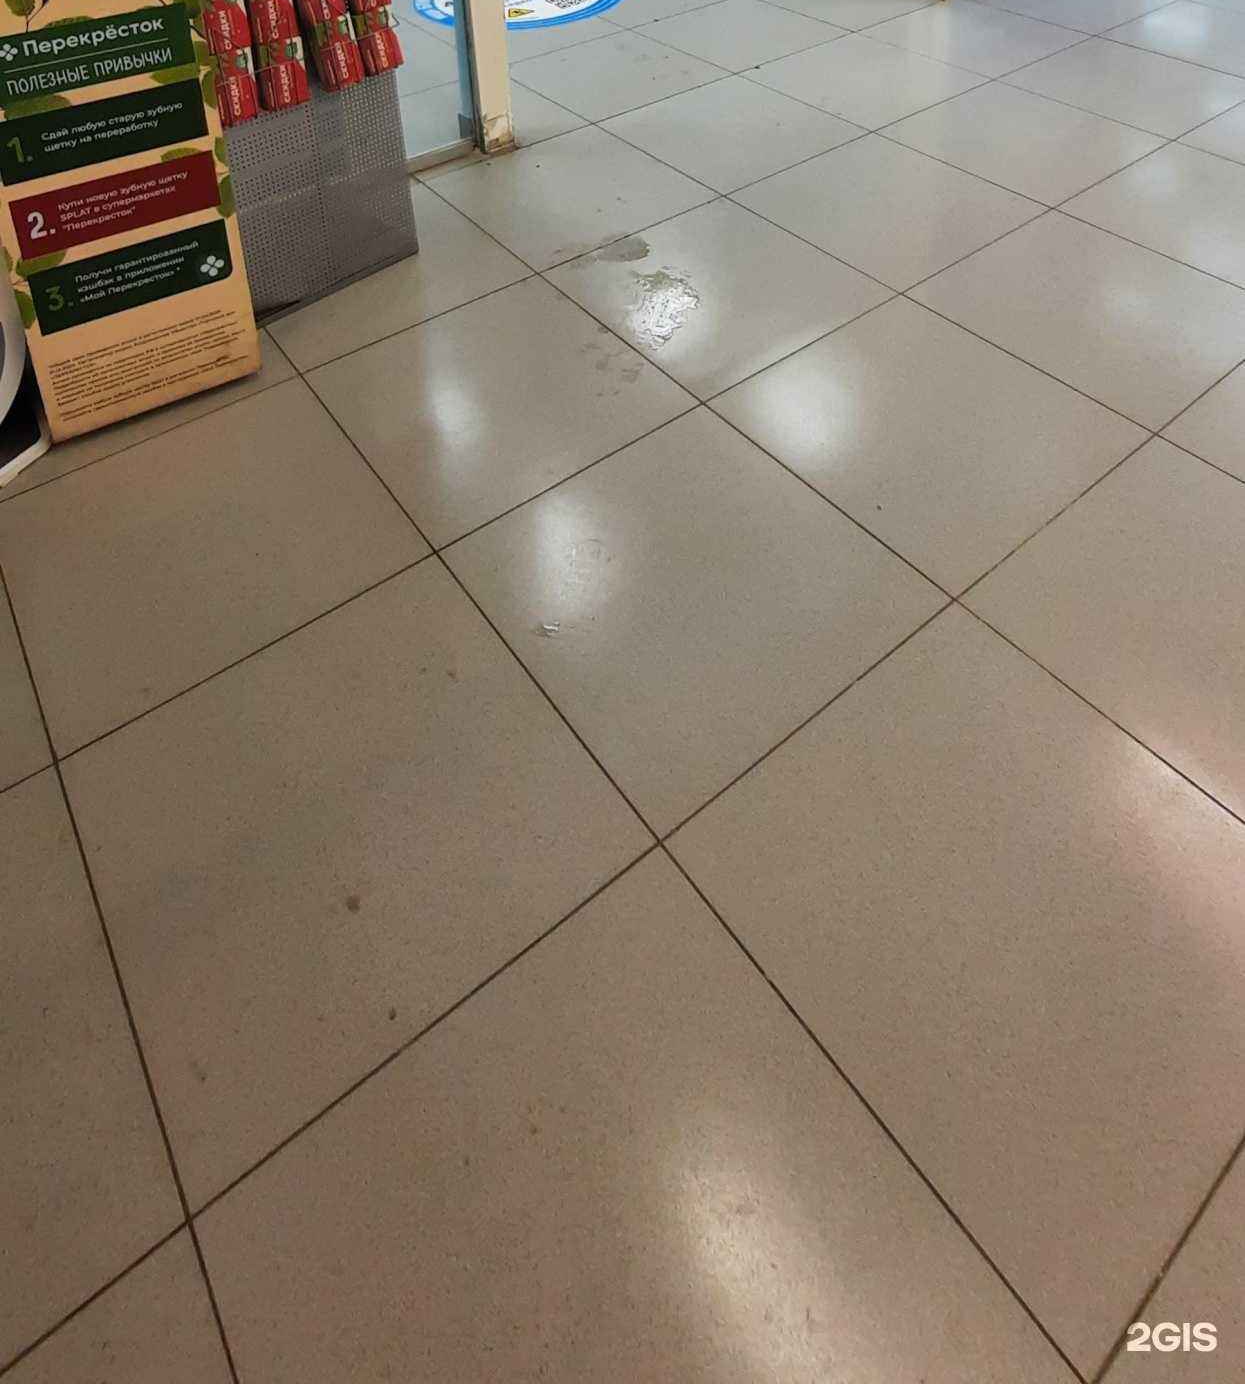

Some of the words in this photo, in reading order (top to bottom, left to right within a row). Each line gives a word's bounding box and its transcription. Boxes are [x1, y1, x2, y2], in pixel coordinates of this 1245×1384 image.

[22, 18, 165, 57] Перекрёсток
[6, 64, 90, 96] ПОЛЕЗНЫЕ
[93, 47, 173, 78] ПРИВЫЧКИ
[41, 128, 69, 142] Сдай
[71, 120, 107, 137] любую
[108, 110, 145, 126] старую
[147, 102, 183, 118] зубную
[44, 138, 78, 153] щетку
[79, 135, 92, 144] на
[94, 119, 159, 141] переработку
[6, 136, 34, 164] 1.
[57, 198, 84, 213] Купи
[85, 189, 118, 205] новую
[120, 180, 156, 196] зубную
[59, 207, 91, 223] SPLAT
[102, 185, 176, 211] супермаркетах
[27, 210, 56, 240] 2.
[75, 267, 113, 284] Получи
[114, 240, 200, 272] гарантированный
[125, 255, 185, 279] приложении
[45, 285, 75, 312] 3.
